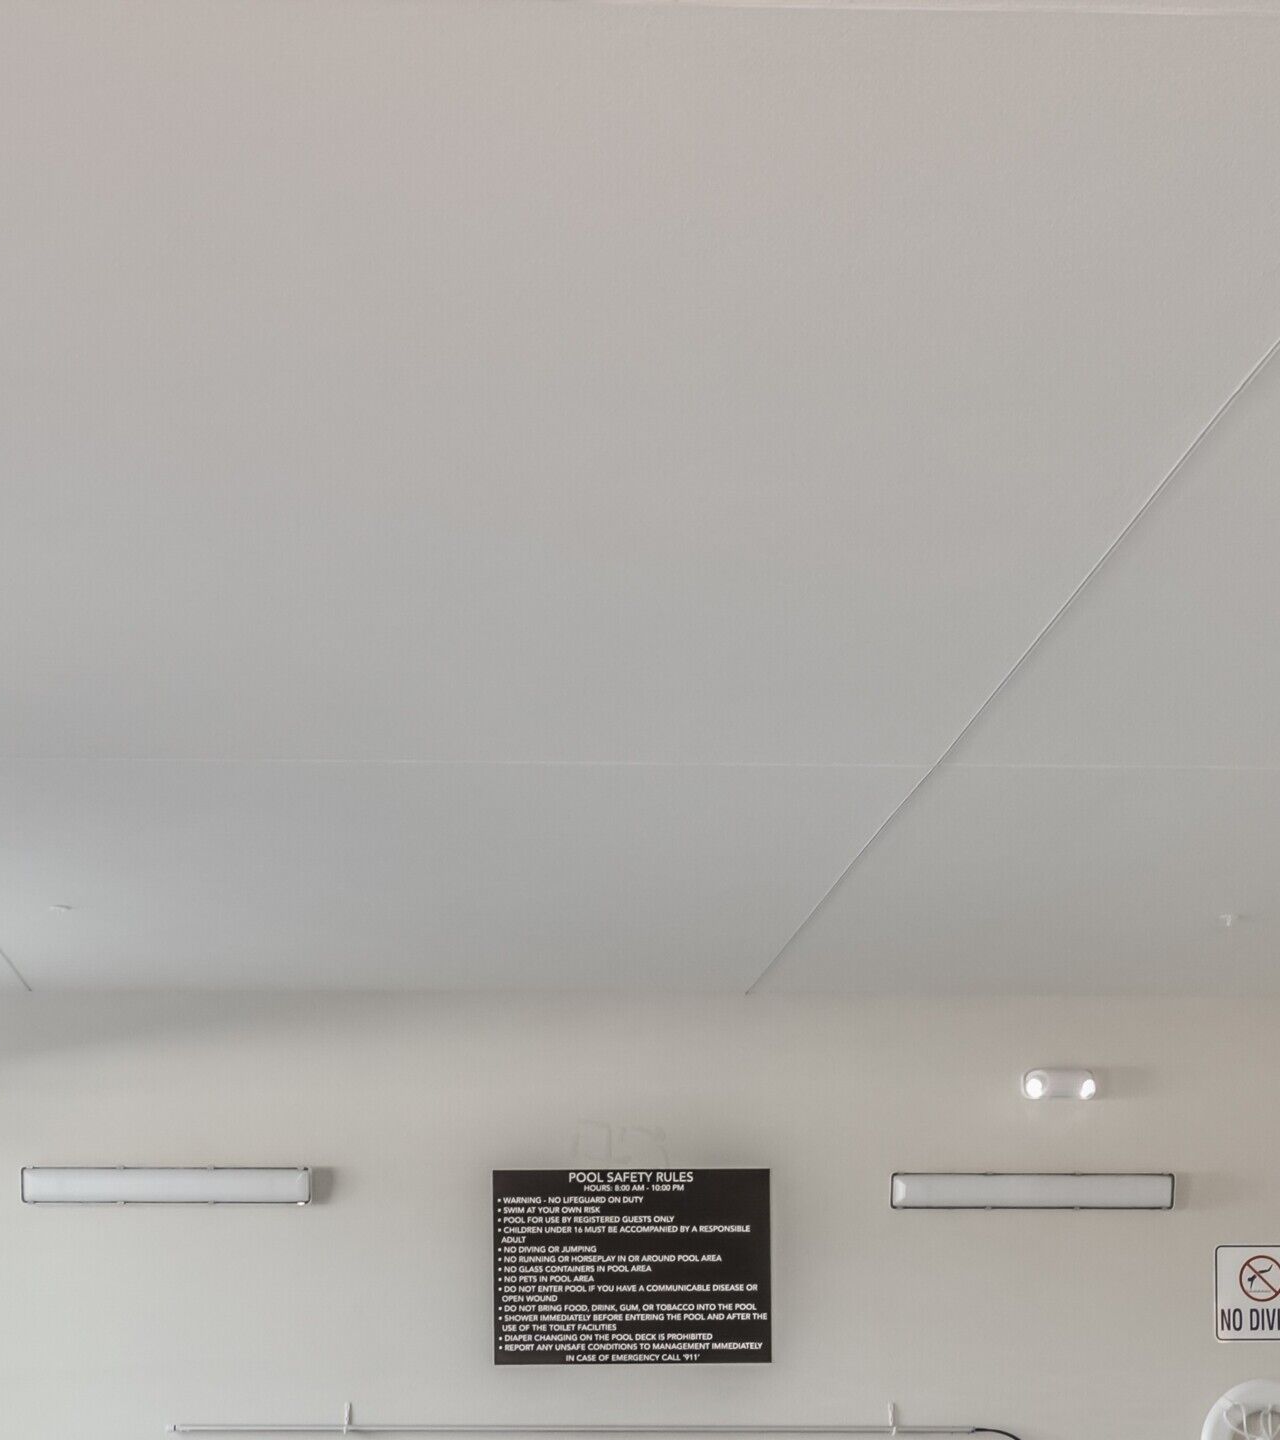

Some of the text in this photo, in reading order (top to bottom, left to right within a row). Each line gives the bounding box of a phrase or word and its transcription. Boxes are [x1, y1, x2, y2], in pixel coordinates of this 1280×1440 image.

[569, 1172, 694, 1183] POOL SAFETY RULES
[563, 1196, 606, 1204] LIFEGUARD
[561, 1206, 582, 1214] OWN
[503, 1216, 526, 1224] POOL
[527, 1216, 544, 1224] FOR
[503, 1226, 543, 1234] CHILDREN
[680, 1225, 690, 1233] BY
[699, 1225, 751, 1233] RESPONSIBLE
[519, 1255, 556, 1263] RUNNING
[571, 1255, 616, 1263] HORSEPLAY
[701, 1254, 722, 1262] AREA
[545, 1265, 595, 1273] CONTAINERS
[519, 1275, 538, 1283] PETS
[518, 1285, 536, 1293] NOT
[538, 1285, 563, 1293] ENTER
[646, 1284, 711, 1292] COMMUNICABLE
[538, 1304, 562, 1312] BRING
[718, 1303, 733, 1311] THE
[504, 1314, 538, 1322] SHOWER
[540, 1314, 592, 1322] IMMEDIATELY
[666, 1313, 682, 1321] THE
[1221, 1308, 1243, 1331] NO
[502, 1324, 517, 1332] USE
[519, 1324, 530, 1332] OF
[532, 1324, 547, 1332] THE
[504, 1334, 532, 1342] DIAPER
[534, 1334, 578, 1342] CHANGING
[635, 1333, 657, 1341] DECK
[658, 1333, 665, 1341] IS
[667, 1333, 713, 1341] PROHIBITED
[555, 1343, 586, 1351] UNSAFE
[652, 1342, 710, 1350] MANAGEMENT
[712, 1342, 763, 1350] IMMEDIATELY
[576, 1354, 596, 1362] CASE
[612, 1354, 660, 1362] EMERGENCY
